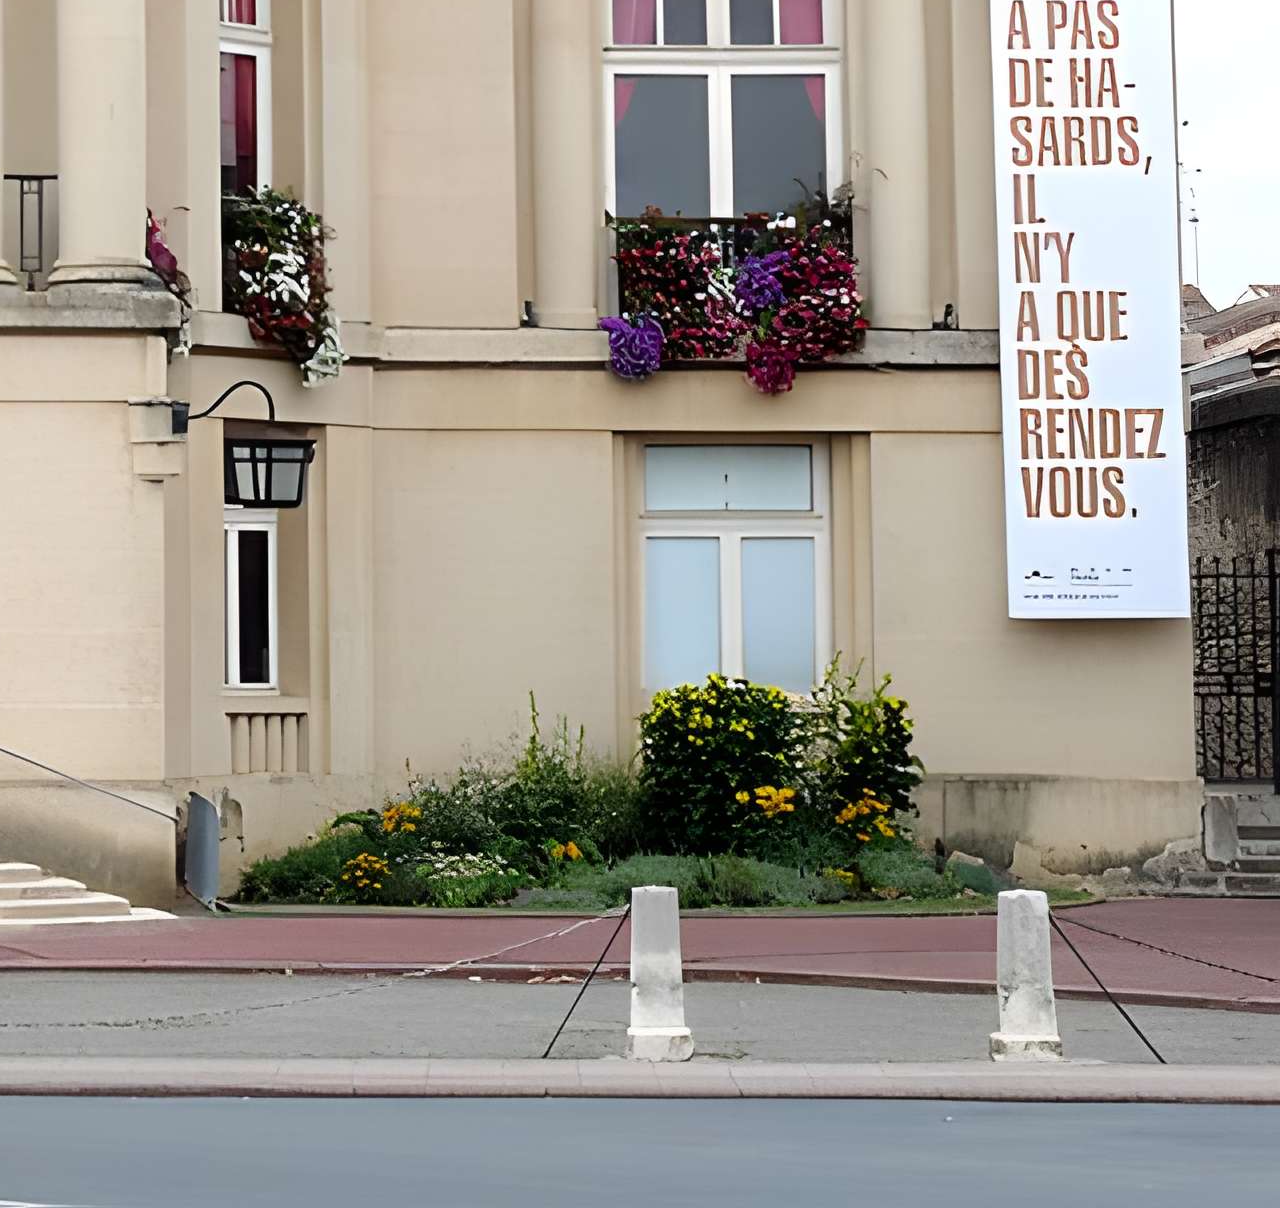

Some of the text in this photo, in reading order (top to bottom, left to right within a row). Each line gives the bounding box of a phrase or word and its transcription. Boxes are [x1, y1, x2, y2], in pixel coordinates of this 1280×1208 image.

[1007, 0, 1119, 50] A PAS
[1009, 57, 1136, 108] DE HA-
[1010, 116, 1152, 175] SARDS,
[1013, 174, 1046, 224] IL
[1014, 232, 1075, 283] N'Y
[1017, 291, 1128, 352] A QUE
[1017, 349, 1089, 400] DES
[1020, 408, 1166, 460] RENDEZ
[1021, 466, 1137, 518] VOUS.
